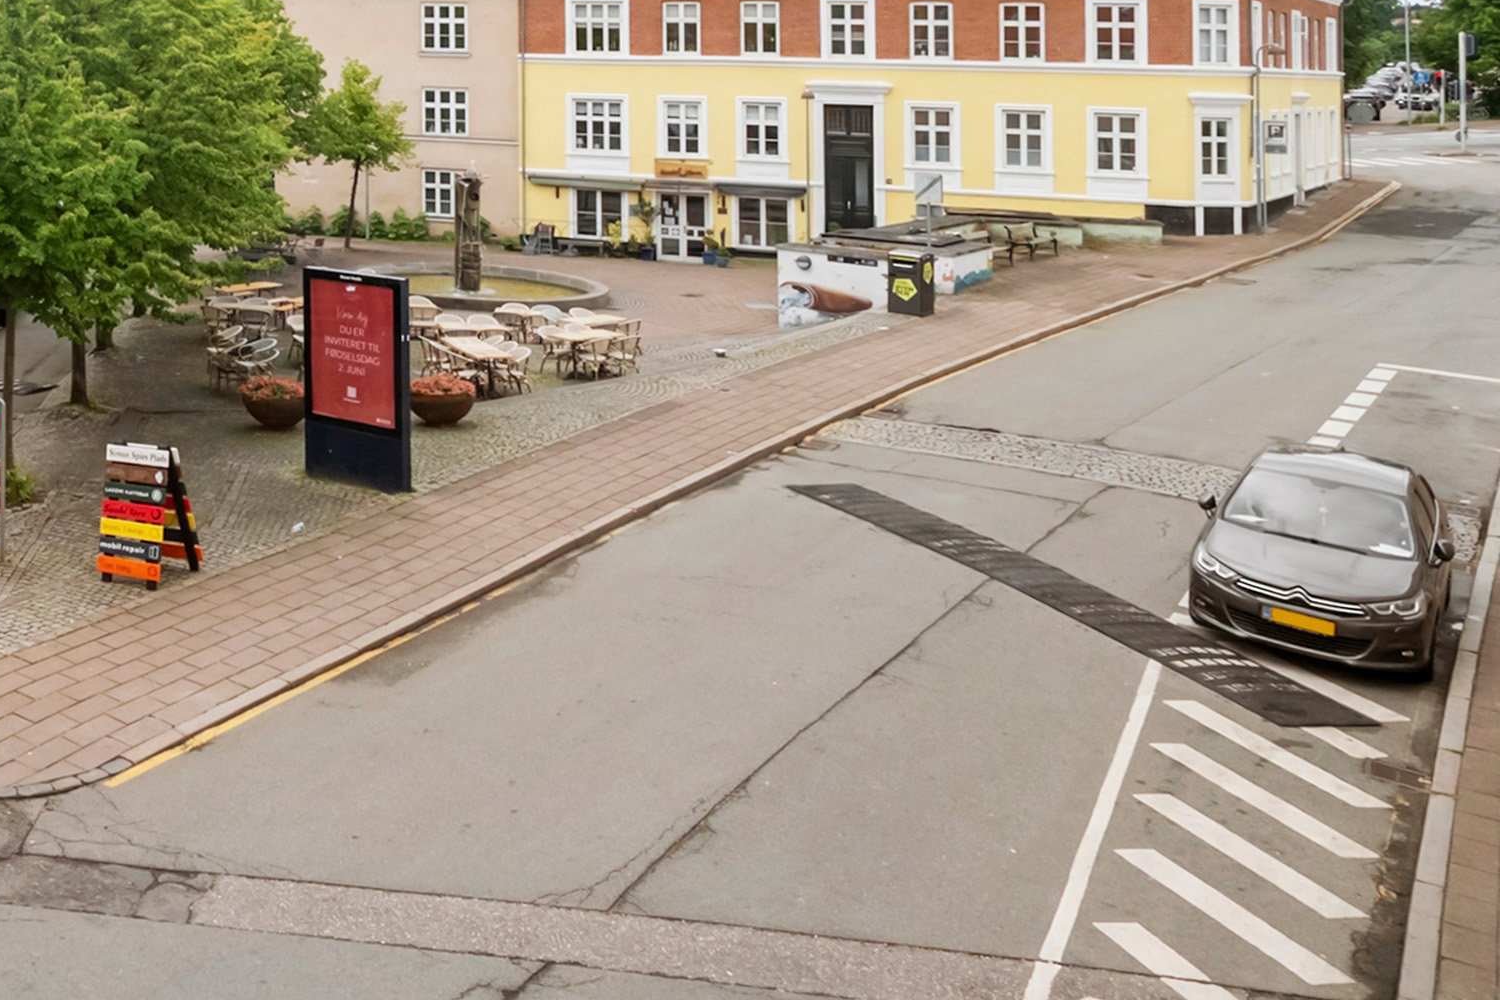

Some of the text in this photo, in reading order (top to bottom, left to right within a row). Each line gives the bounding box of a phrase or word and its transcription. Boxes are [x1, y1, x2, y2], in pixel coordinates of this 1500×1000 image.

[339, 325, 365, 337] DU ER
[324, 335, 380, 353] INVITERET TIL
[325, 347, 380, 366] FØDSELSDAG
[347, 365, 366, 376] JUNI
[100, 541, 145, 555] mobil repair
